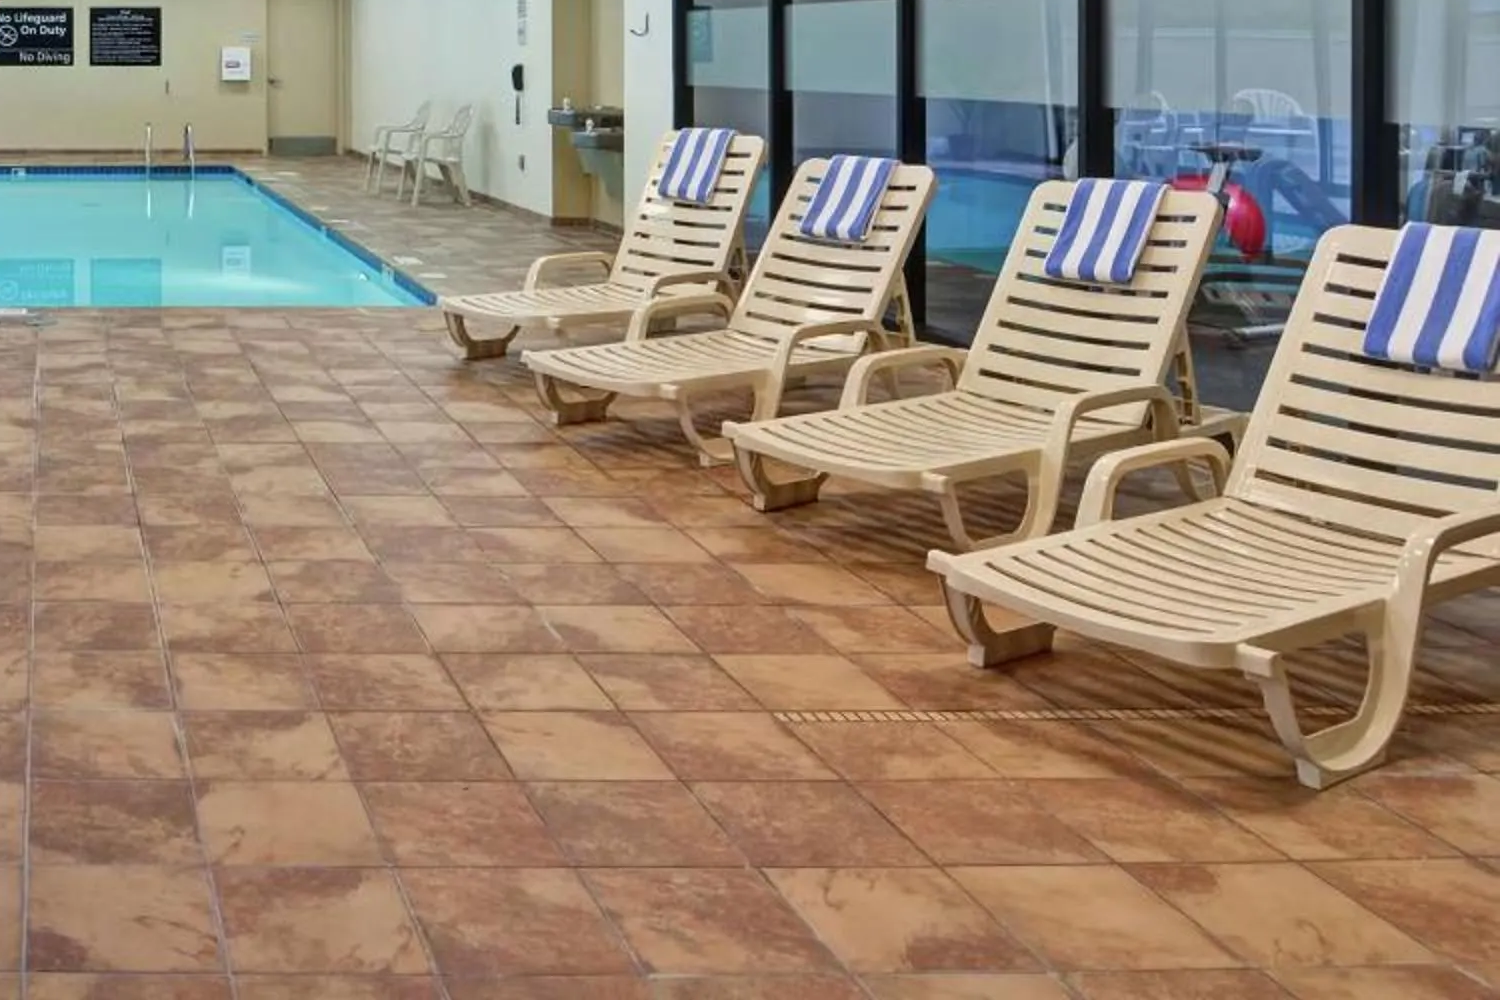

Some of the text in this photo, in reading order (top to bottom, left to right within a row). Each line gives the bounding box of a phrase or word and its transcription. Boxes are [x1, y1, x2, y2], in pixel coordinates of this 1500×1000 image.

[14, 12, 67, 25] Lifeguard
[20, 25, 66, 37] On Duty
[20, 50, 71, 64] No Diving
